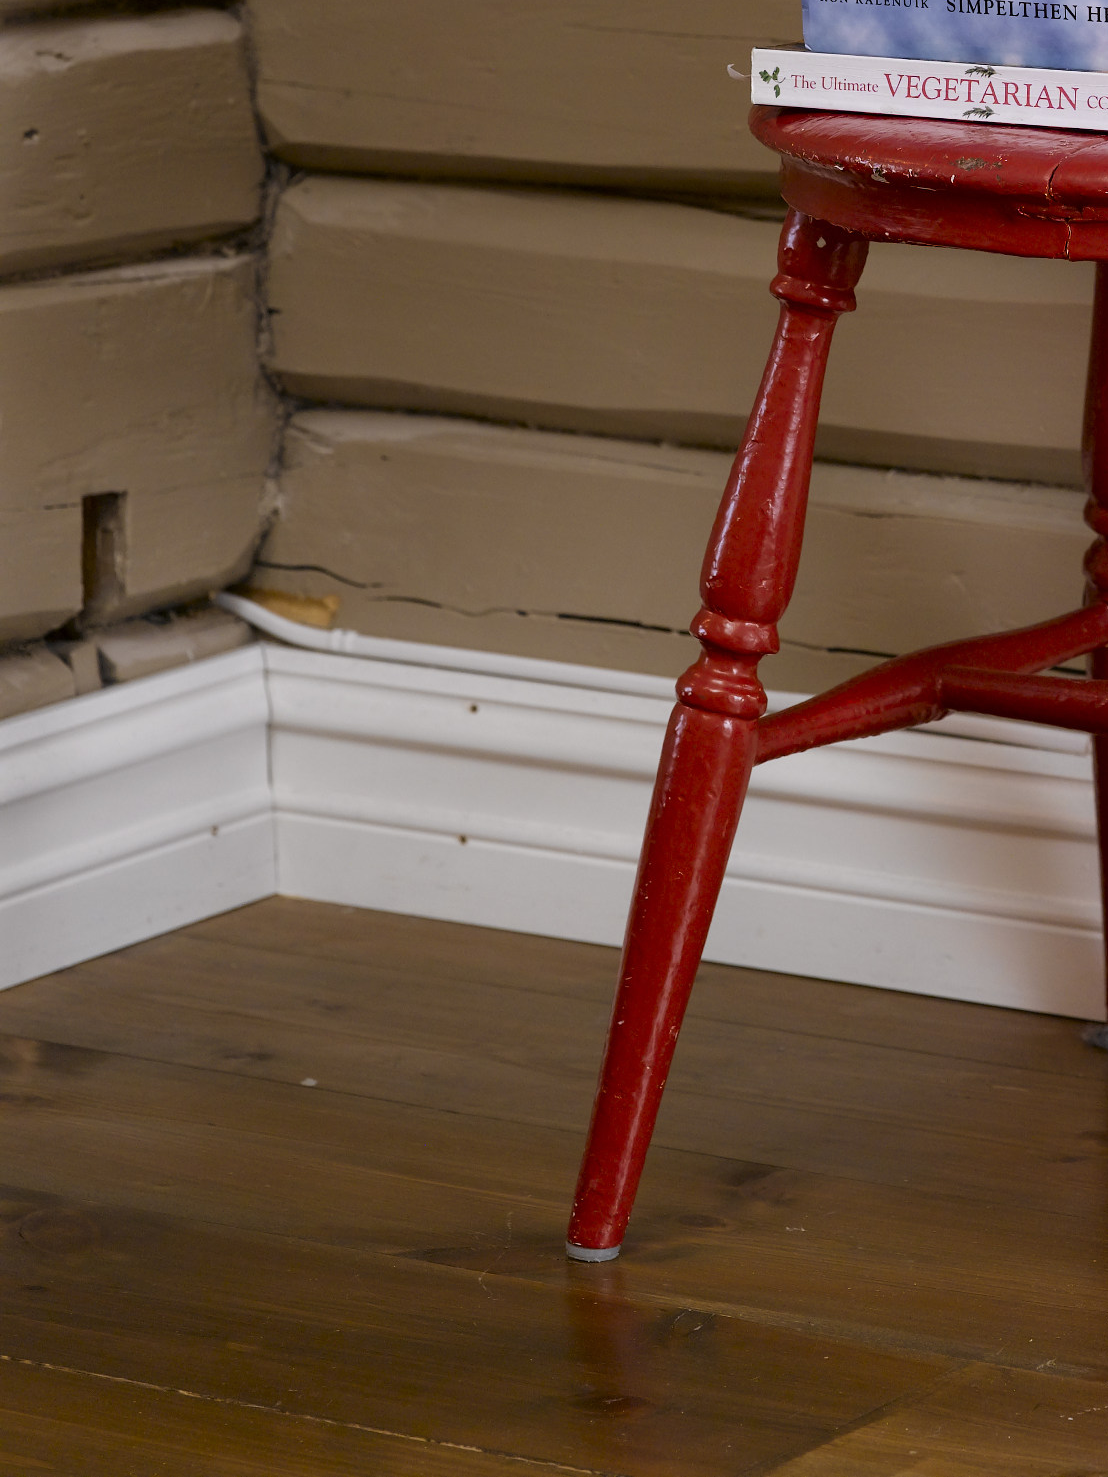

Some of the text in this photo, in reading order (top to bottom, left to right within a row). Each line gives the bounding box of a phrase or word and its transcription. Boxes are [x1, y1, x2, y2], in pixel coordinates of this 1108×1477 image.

[790, 74, 817, 90] The
[820, 75, 880, 94] Ultimate
[883, 73, 1080, 112] VEGETARIAN
